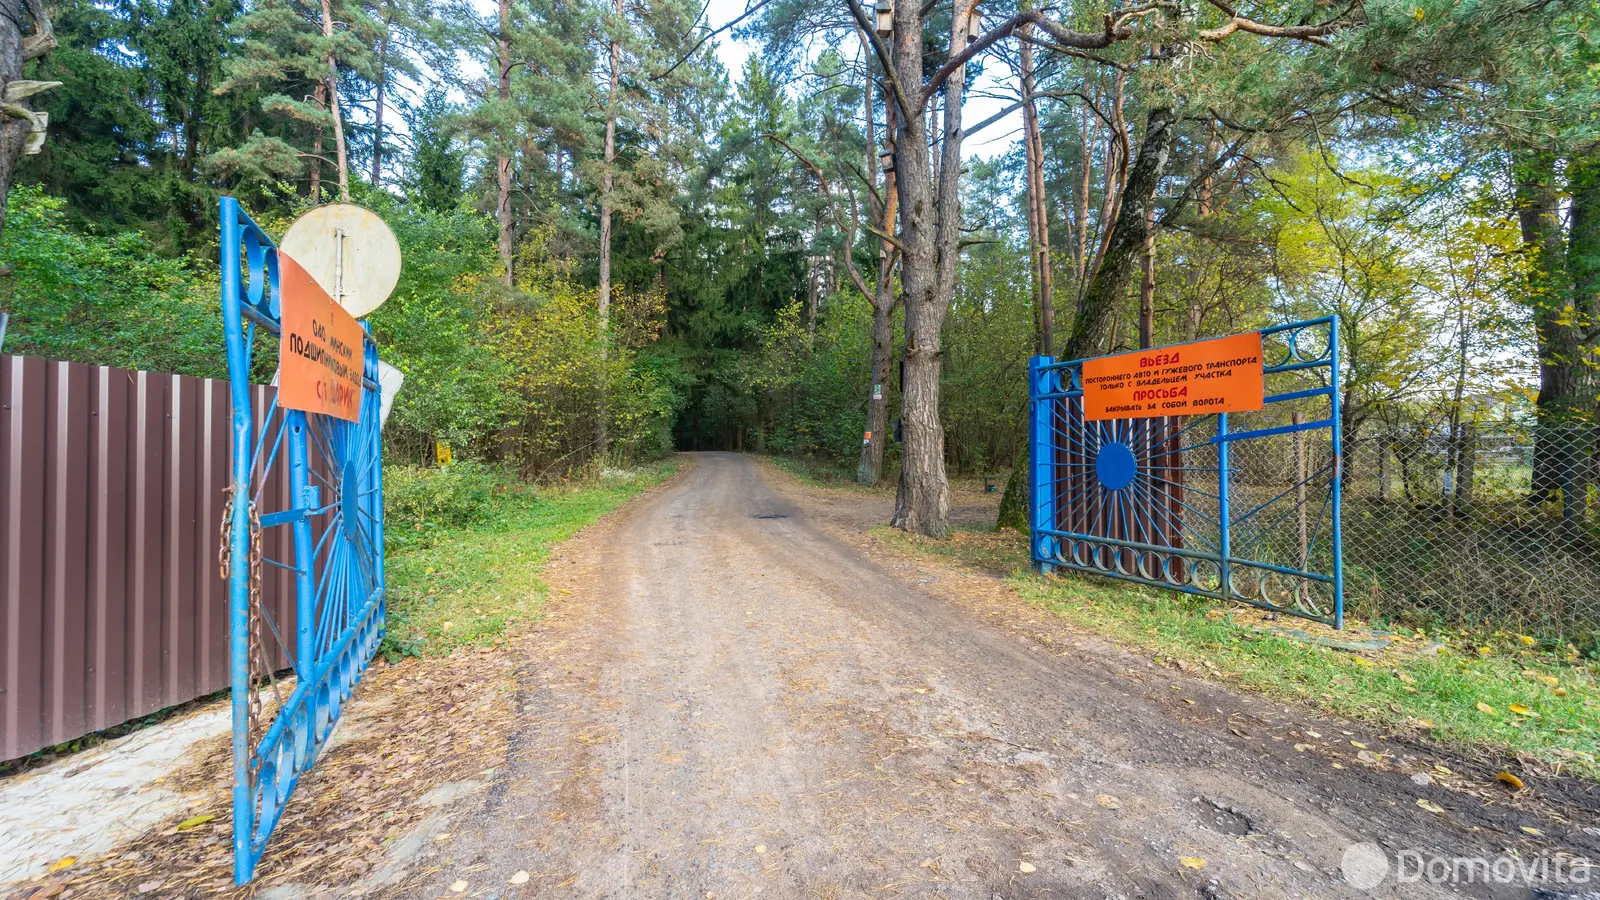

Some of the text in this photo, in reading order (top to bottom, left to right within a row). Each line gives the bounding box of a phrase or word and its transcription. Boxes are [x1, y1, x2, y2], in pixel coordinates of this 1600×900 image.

[312, 319, 326, 342] ОАО
[1086, 374, 1131, 384] ПОСТОРОННЕГО
[1162, 364, 1202, 374] ГУЖЕВОГО
[1206, 357, 1257, 370] ТРАНСПОРТА
[1136, 375, 1188, 386] ВЛАДЕЛЬЦЕМ
[1194, 370, 1232, 380] УЧАСТКА
[1133, 386, 1187, 401] ПРОСЬБА
[1105, 404, 1142, 412] ЗАКРЫВАТЬ
[1162, 400, 1187, 408] СОБОЙ
[1192, 398, 1224, 406] ВОРОТА
